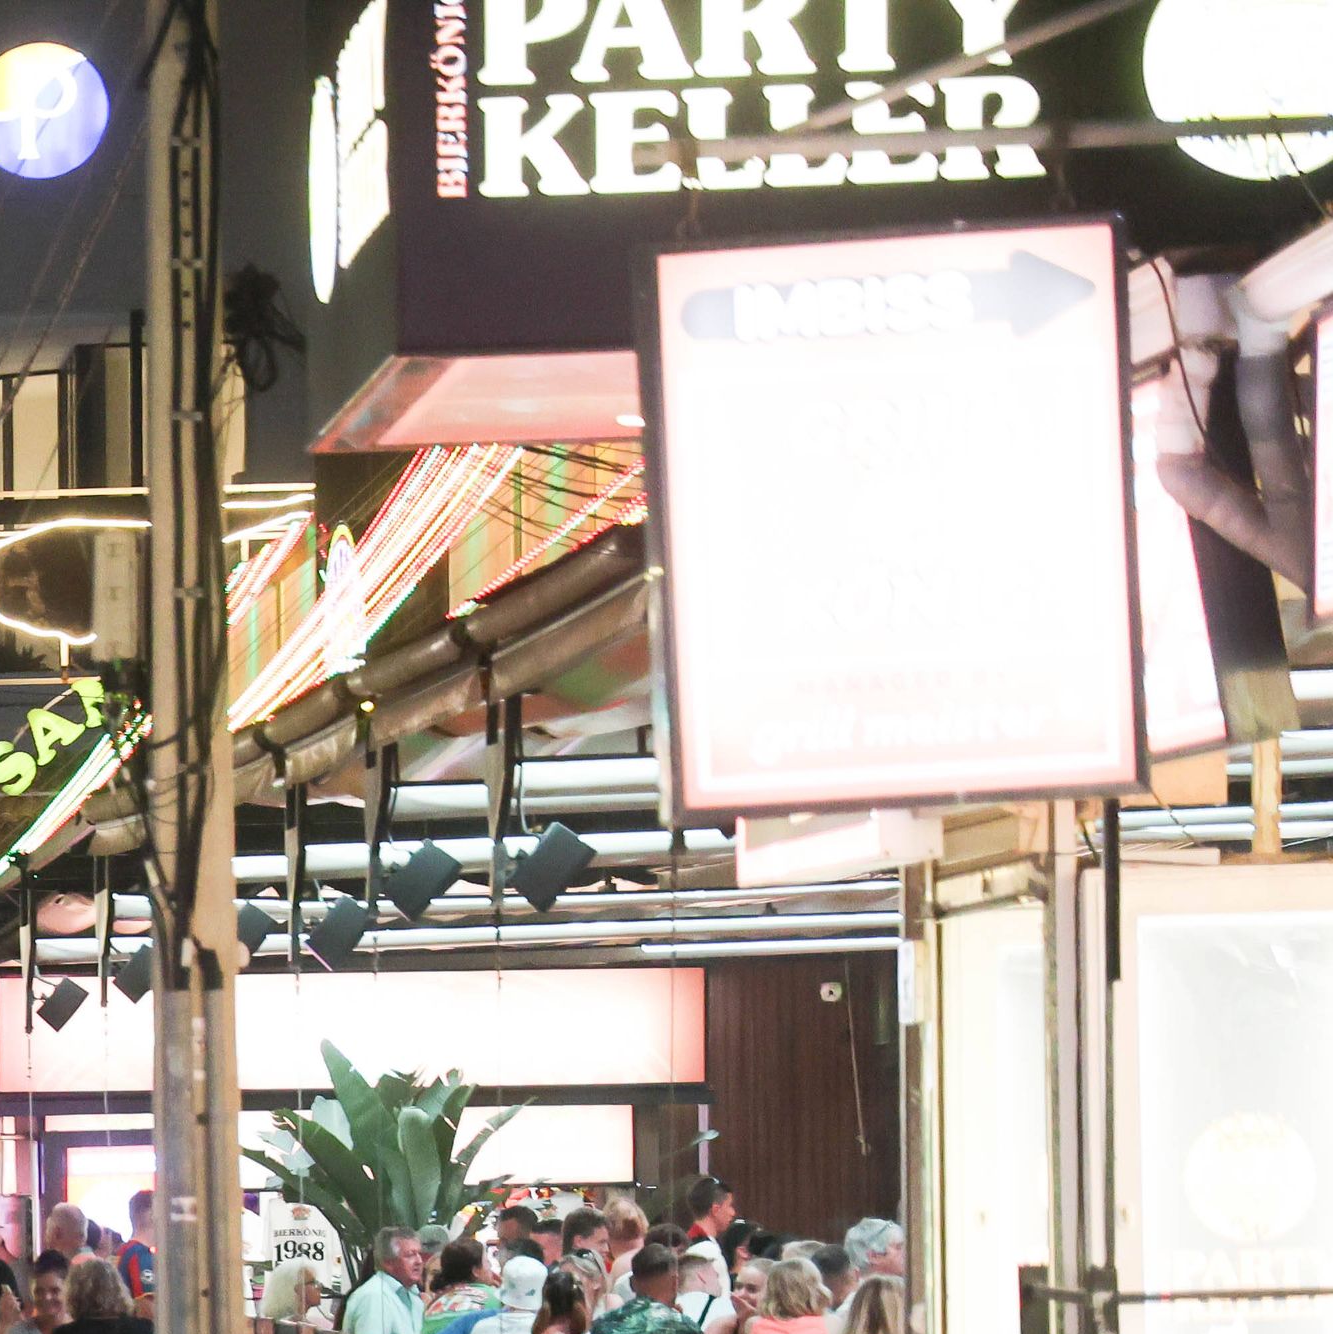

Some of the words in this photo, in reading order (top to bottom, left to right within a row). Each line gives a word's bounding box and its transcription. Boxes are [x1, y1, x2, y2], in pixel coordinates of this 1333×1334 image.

[477, 0, 1022, 85] PARTY
[430, 0, 468, 198] BIERKÖNI
[477, 75, 1047, 198] KELLER
[732, 269, 973, 343] IMBISS
[275, 1240, 325, 1262] 1988
